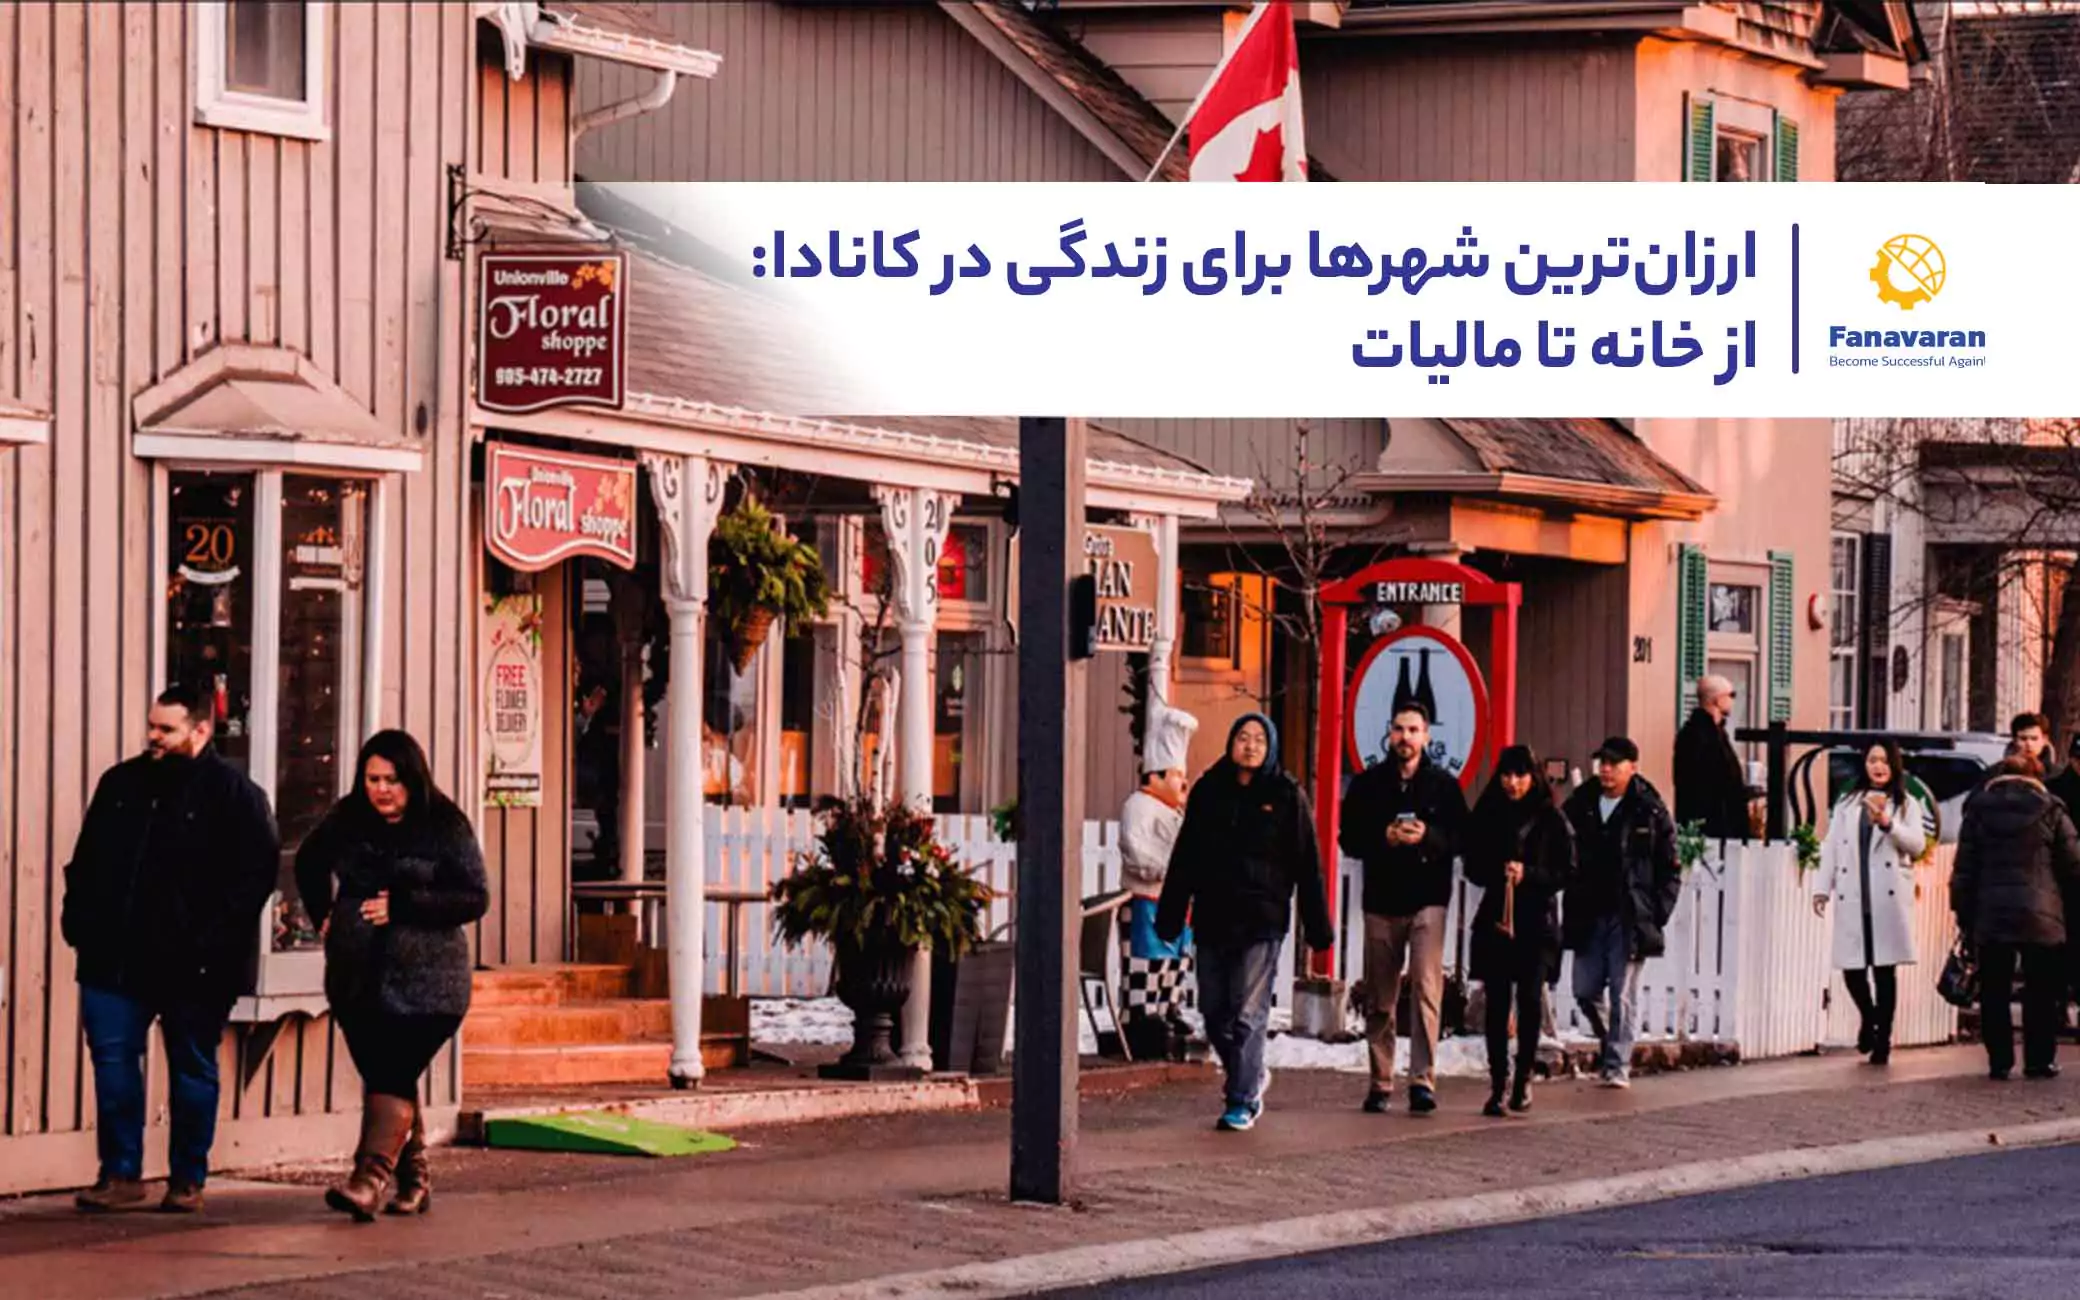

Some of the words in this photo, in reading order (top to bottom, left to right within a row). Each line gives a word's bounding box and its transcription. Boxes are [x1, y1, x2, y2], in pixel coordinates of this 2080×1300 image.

[493, 270, 569, 287] Unionville
[488, 295, 612, 340] Floral
[541, 329, 608, 358] shoppe
[498, 477, 577, 540] Floral
[186, 524, 235, 564] 20
[1377, 582, 1462, 603] ENTRANCE
[496, 664, 527, 688] FREE
